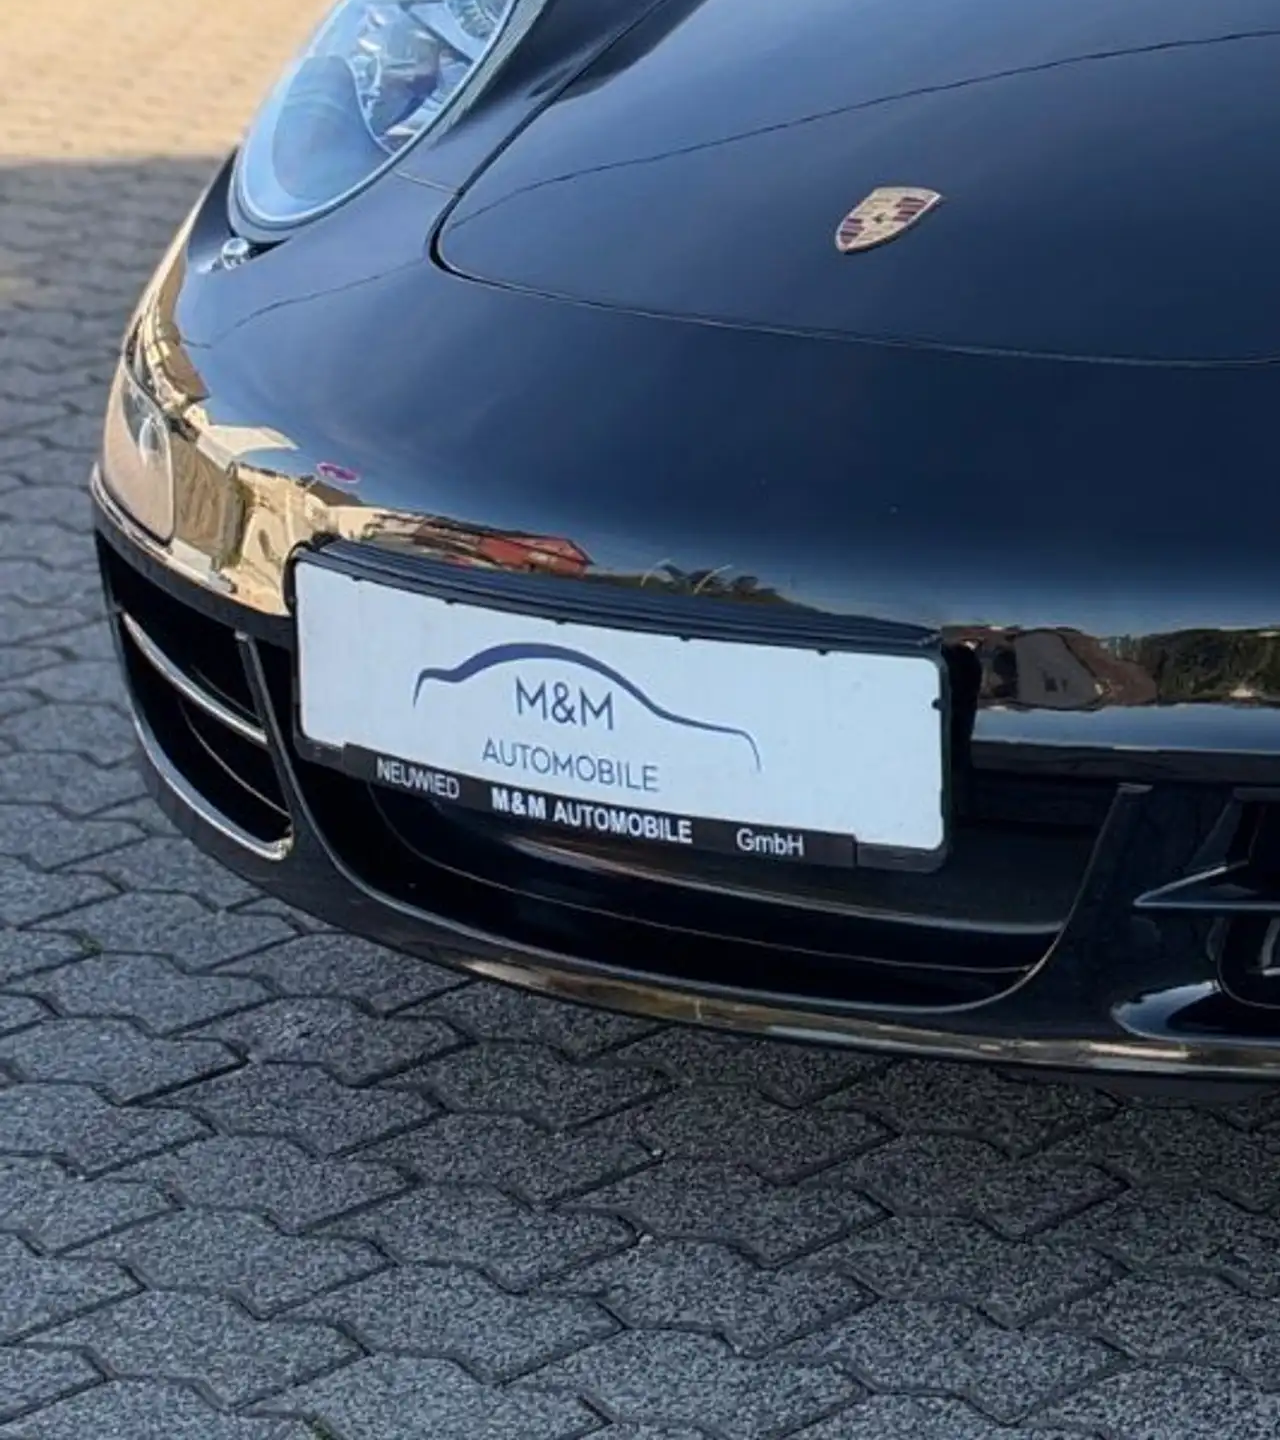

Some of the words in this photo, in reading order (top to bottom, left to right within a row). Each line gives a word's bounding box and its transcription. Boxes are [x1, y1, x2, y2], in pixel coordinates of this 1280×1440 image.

[515, 676, 615, 730] M&M
[483, 738, 661, 792] AUTOMOBILE
[376, 756, 460, 800] NEUWIED
[491, 786, 546, 820] M&M
[553, 801, 693, 844] AUTOMOBILE
[736, 827, 804, 856] GmbH
